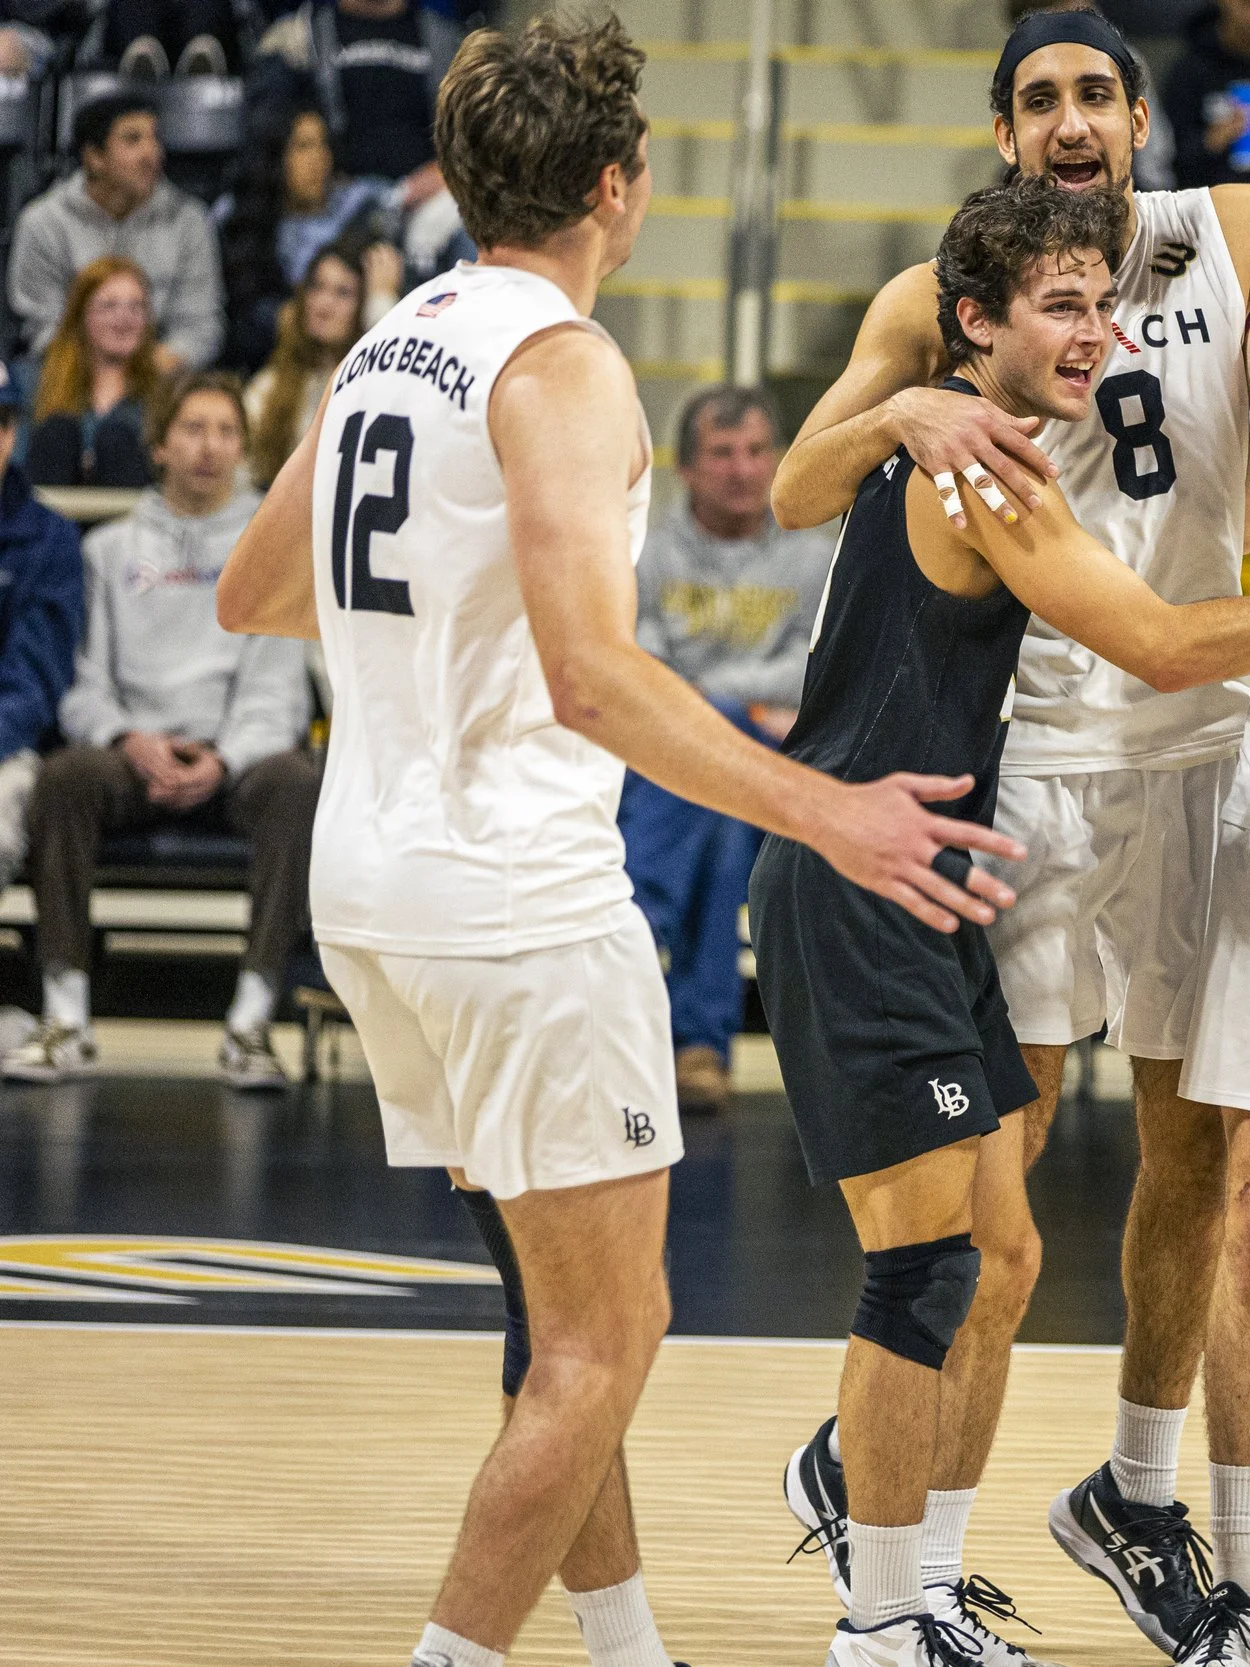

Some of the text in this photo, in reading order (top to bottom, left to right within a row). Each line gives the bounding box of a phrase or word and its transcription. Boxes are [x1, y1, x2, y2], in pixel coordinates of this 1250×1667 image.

[334, 337, 475, 411] LONG BEACH
[1095, 369, 1177, 501] 8
[331, 410, 415, 617] 12
[621, 1106, 656, 1151] LB
[927, 1077, 970, 1120] LB
